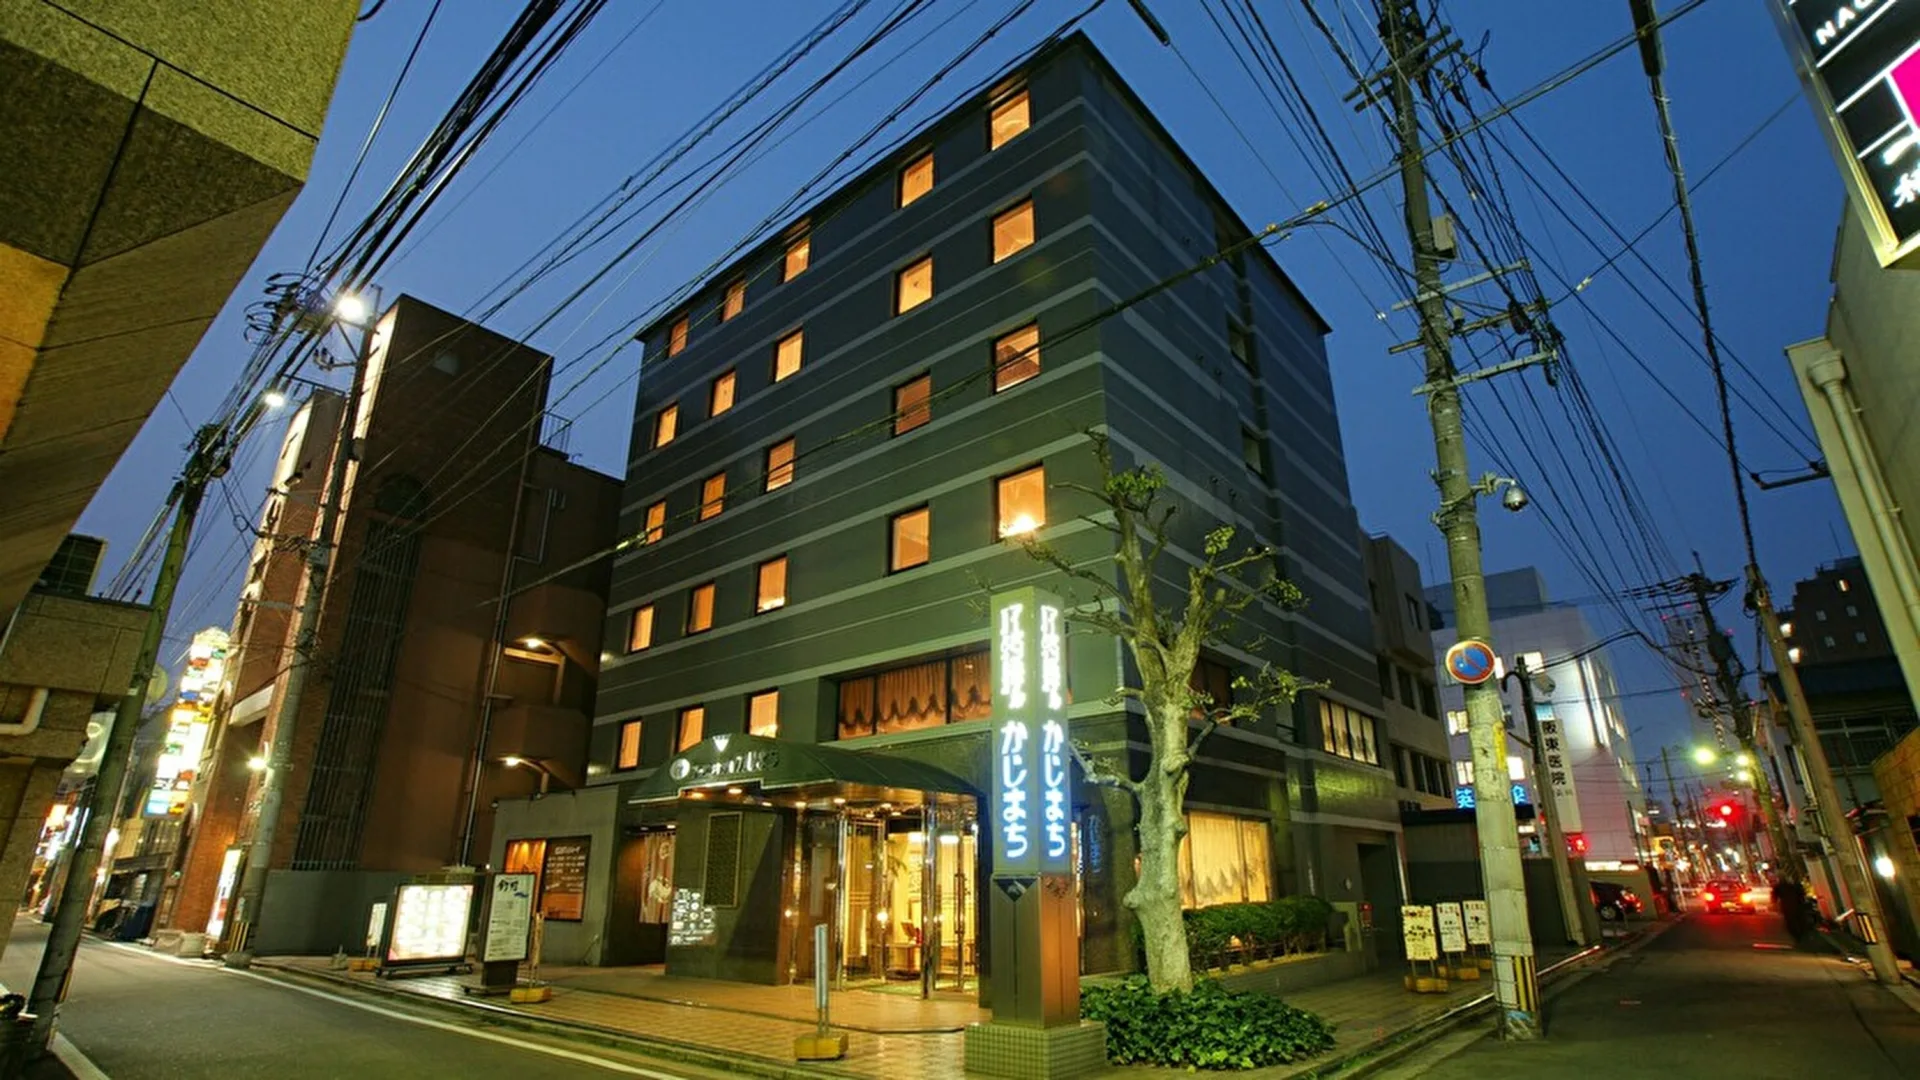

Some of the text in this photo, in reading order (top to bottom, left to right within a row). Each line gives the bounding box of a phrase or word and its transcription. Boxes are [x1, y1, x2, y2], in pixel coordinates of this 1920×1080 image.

[1000, 720, 1028, 858] かじまち
[1042, 719, 1066, 858] かじまち
